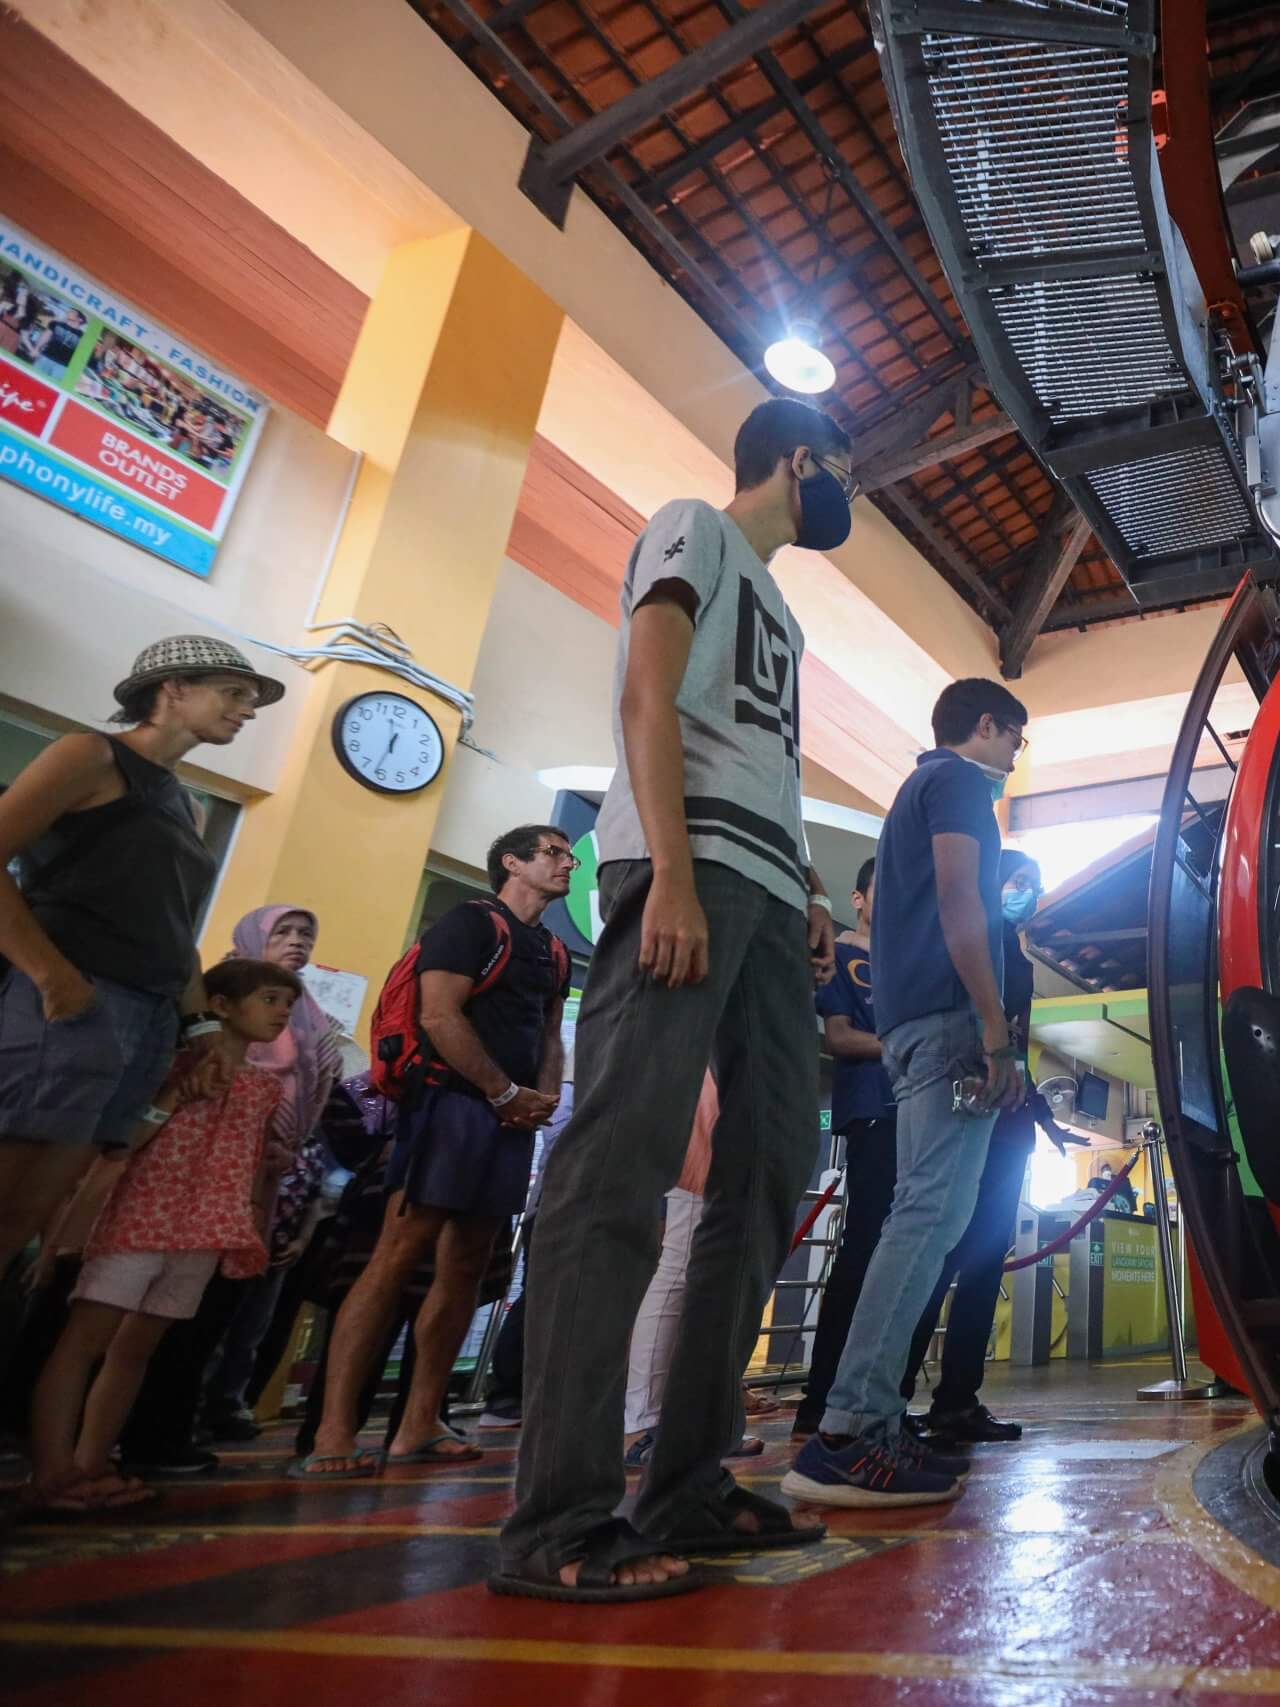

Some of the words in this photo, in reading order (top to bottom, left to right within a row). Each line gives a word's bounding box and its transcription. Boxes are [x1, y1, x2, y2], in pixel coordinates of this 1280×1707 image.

[0, 234, 148, 338] ANDICRAFT
[168, 348, 259, 412] FASHION
[100, 432, 188, 489] BRANDS
[98, 449, 182, 501] OUTLET
[359, 707, 374, 721] 10
[376, 702, 388, 715] 11
[393, 705, 407, 719] 12
[350, 721, 360, 733] 9
[413, 719, 419, 729] 1
[349, 740, 360, 752] 8
[419, 734, 430, 746] 2
[361, 756, 372, 768] 7
[419, 752, 429, 764] 3
[376, 769, 387, 781] 6
[395, 771, 405, 783] 5
[410, 766, 419, 776] 4
[1111, 1240, 1133, 1254] VIEW
[1135, 1242, 1156, 1256] YOUR
[1090, 1252, 1104, 1265] EXIT
